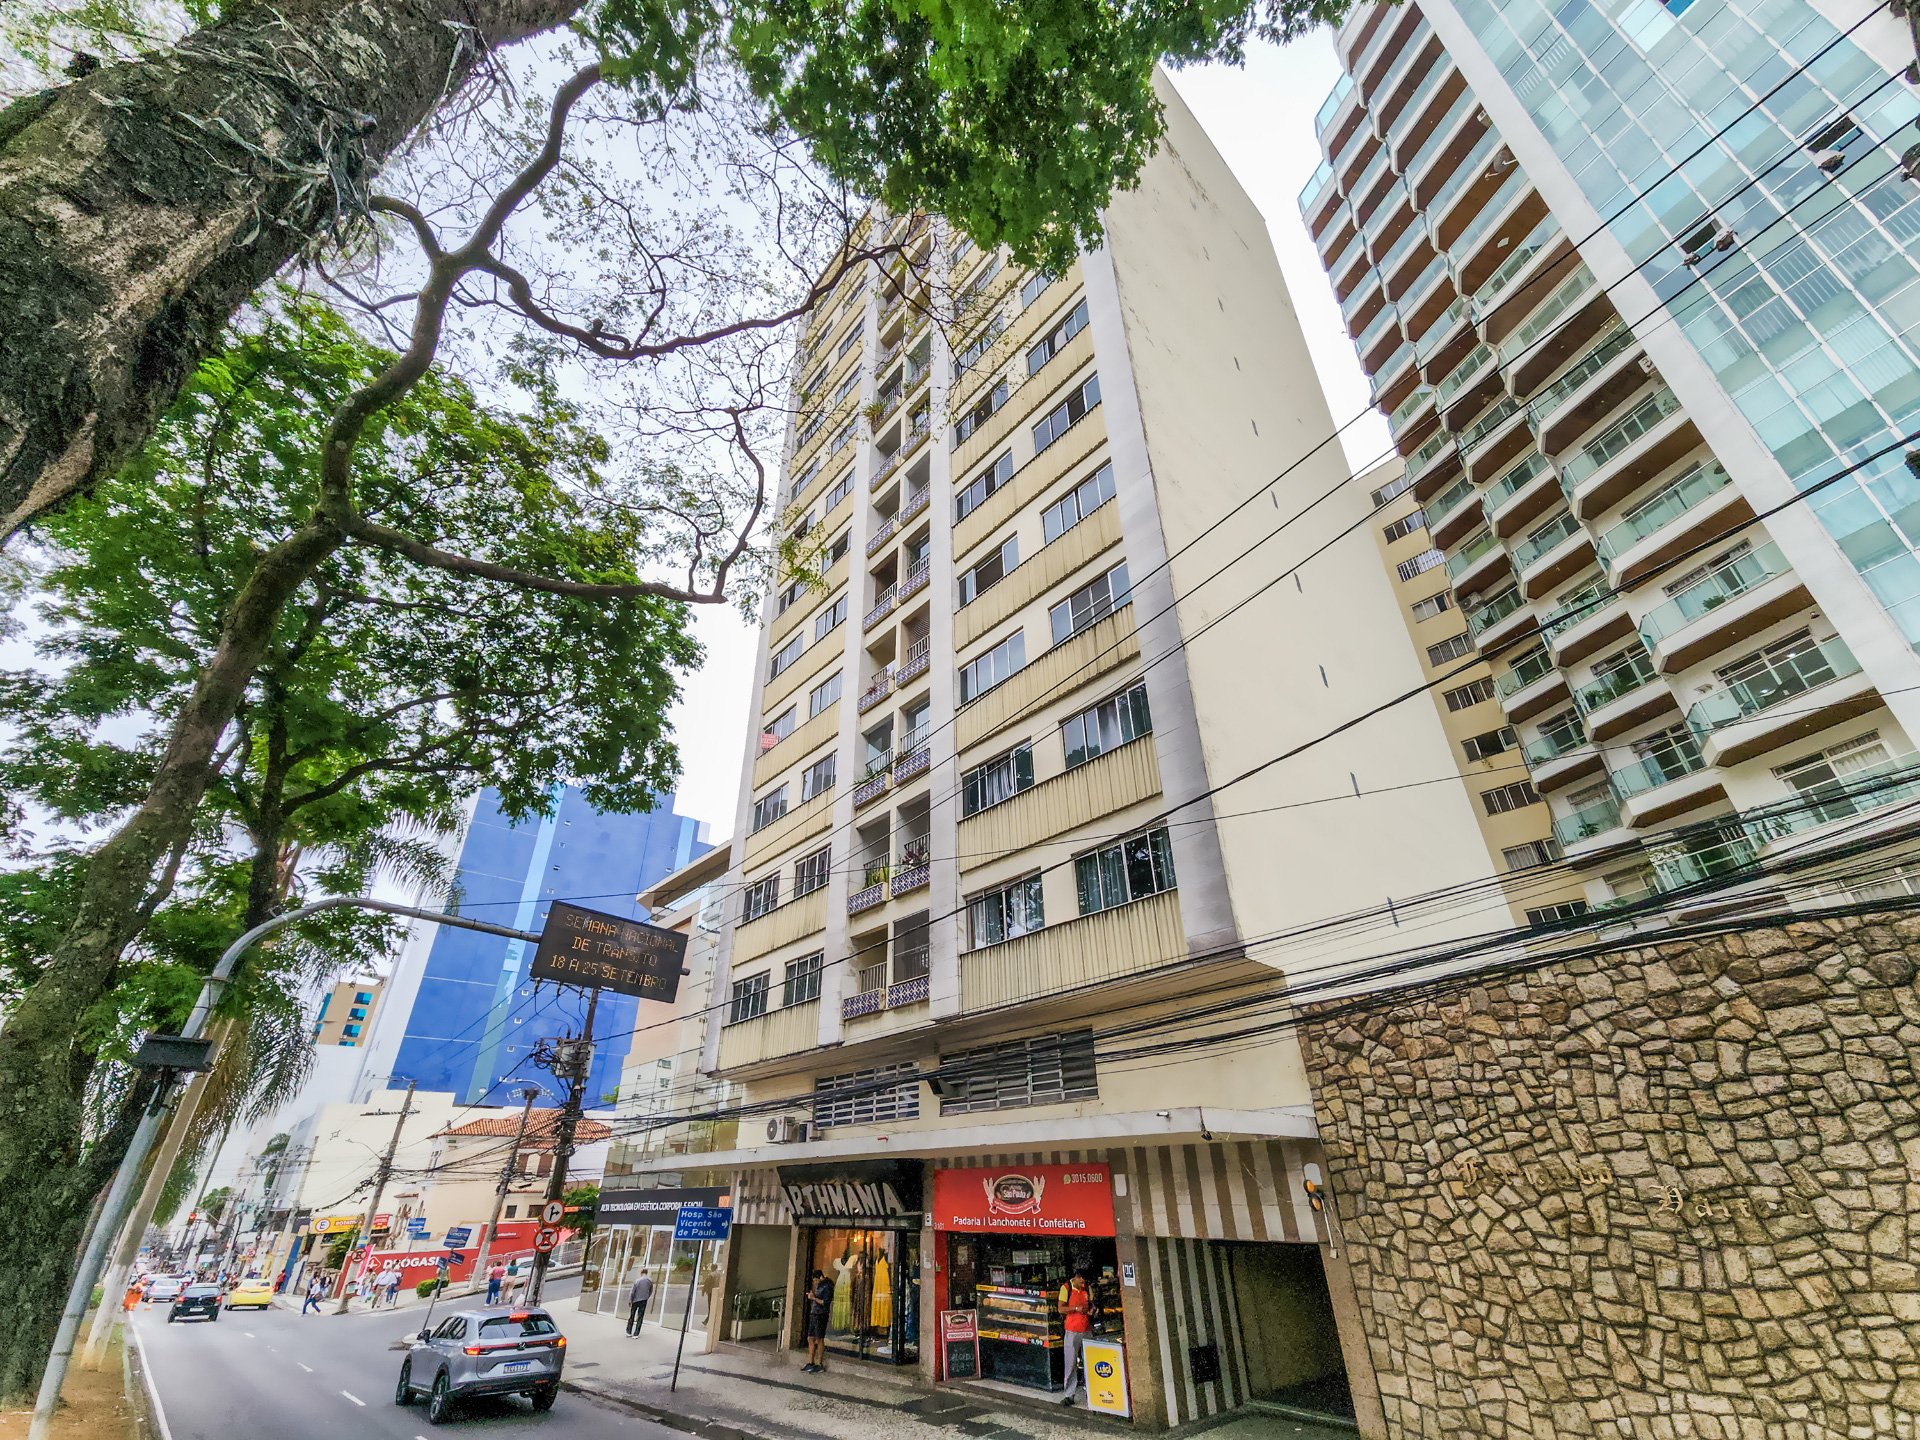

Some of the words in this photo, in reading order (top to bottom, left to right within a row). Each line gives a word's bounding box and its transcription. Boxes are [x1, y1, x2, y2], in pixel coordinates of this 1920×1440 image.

[564, 913, 617, 937] SEMANA
[620, 927, 679, 953] NACIONAL
[571, 936, 592, 952] DE
[550, 954, 566, 969] 18
[568, 958, 580, 972] A
[582, 961, 599, 976] 25
[601, 965, 667, 989] SETEMBRO
[708, 1210, 723, 1218] São
[953, 1216, 981, 1226] Padaria
[987, 1217, 1031, 1228] Lanchonete
[1038, 1217, 1086, 1229] Confeitaria
